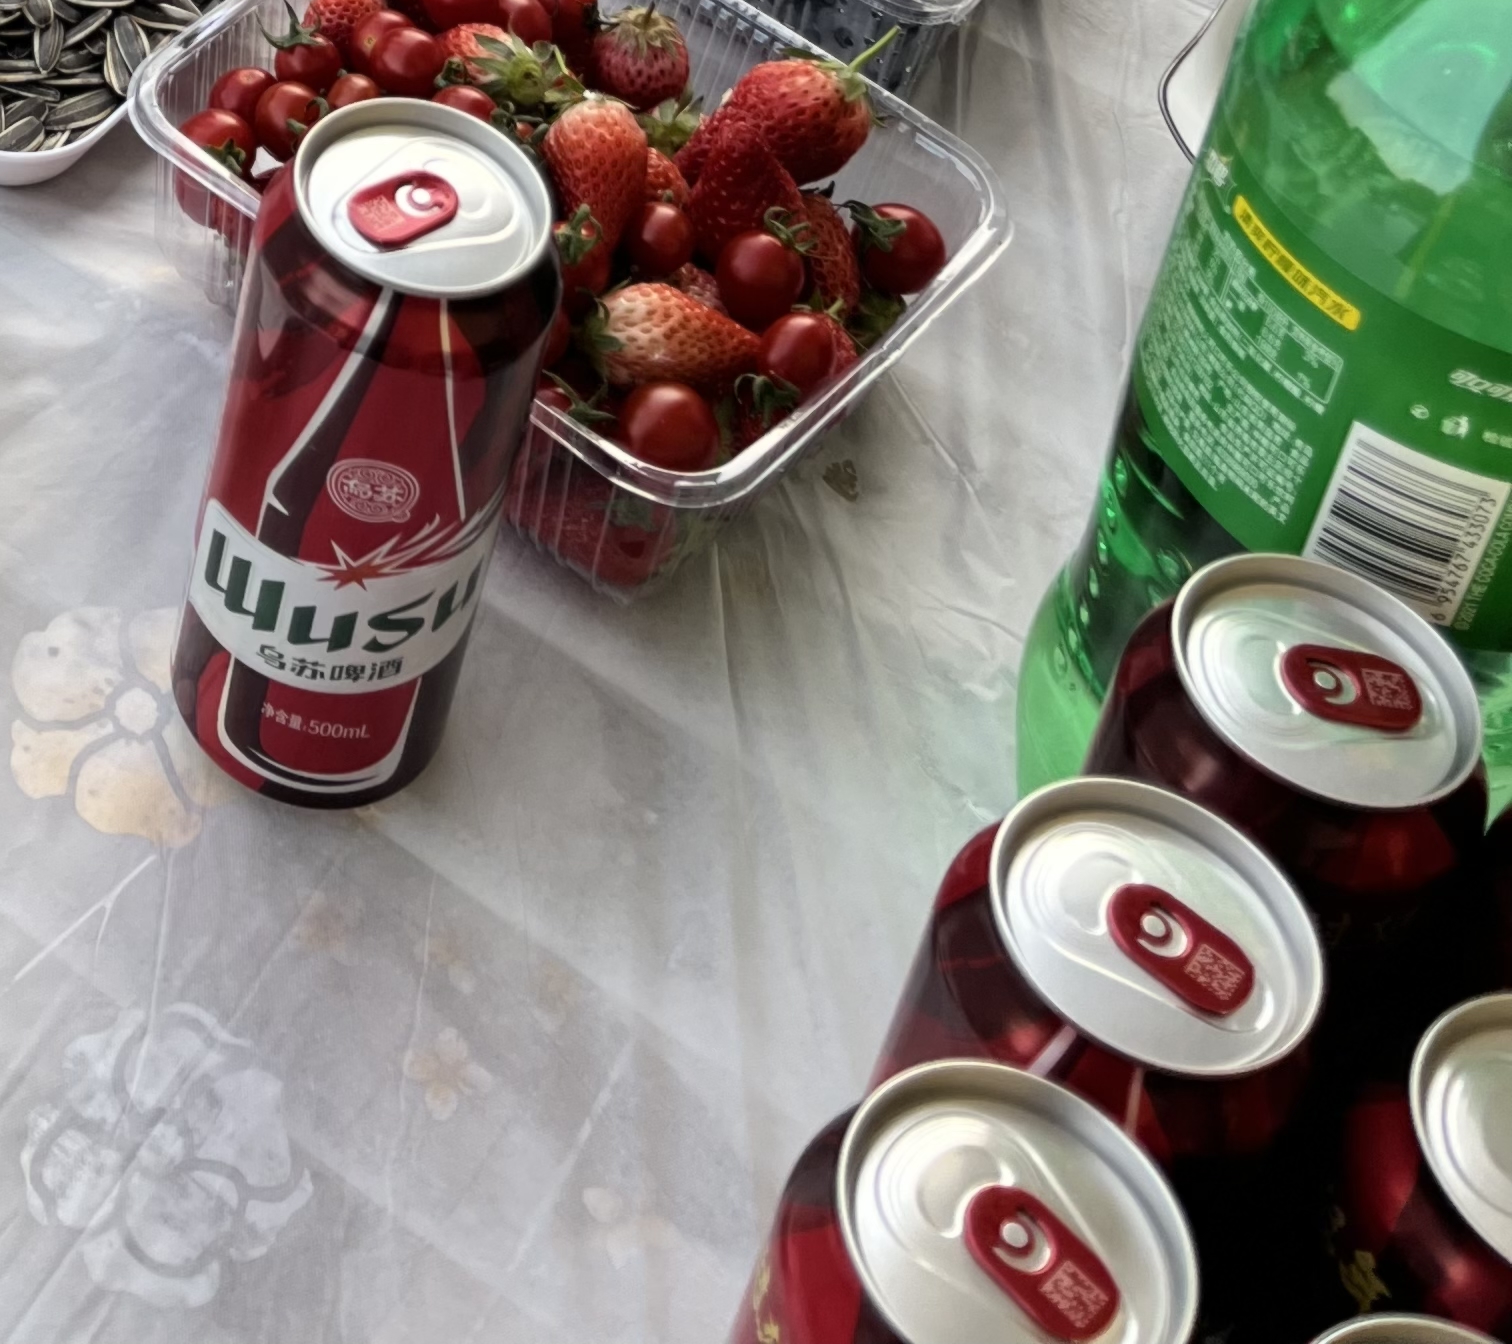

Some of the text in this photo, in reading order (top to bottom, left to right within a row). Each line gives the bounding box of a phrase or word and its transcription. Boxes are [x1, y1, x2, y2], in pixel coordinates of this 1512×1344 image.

[1437, 552, 1472, 605] 954767
[1461, 496, 1498, 550] 433073
[256, 643, 404, 683] 乌苏啤酒
